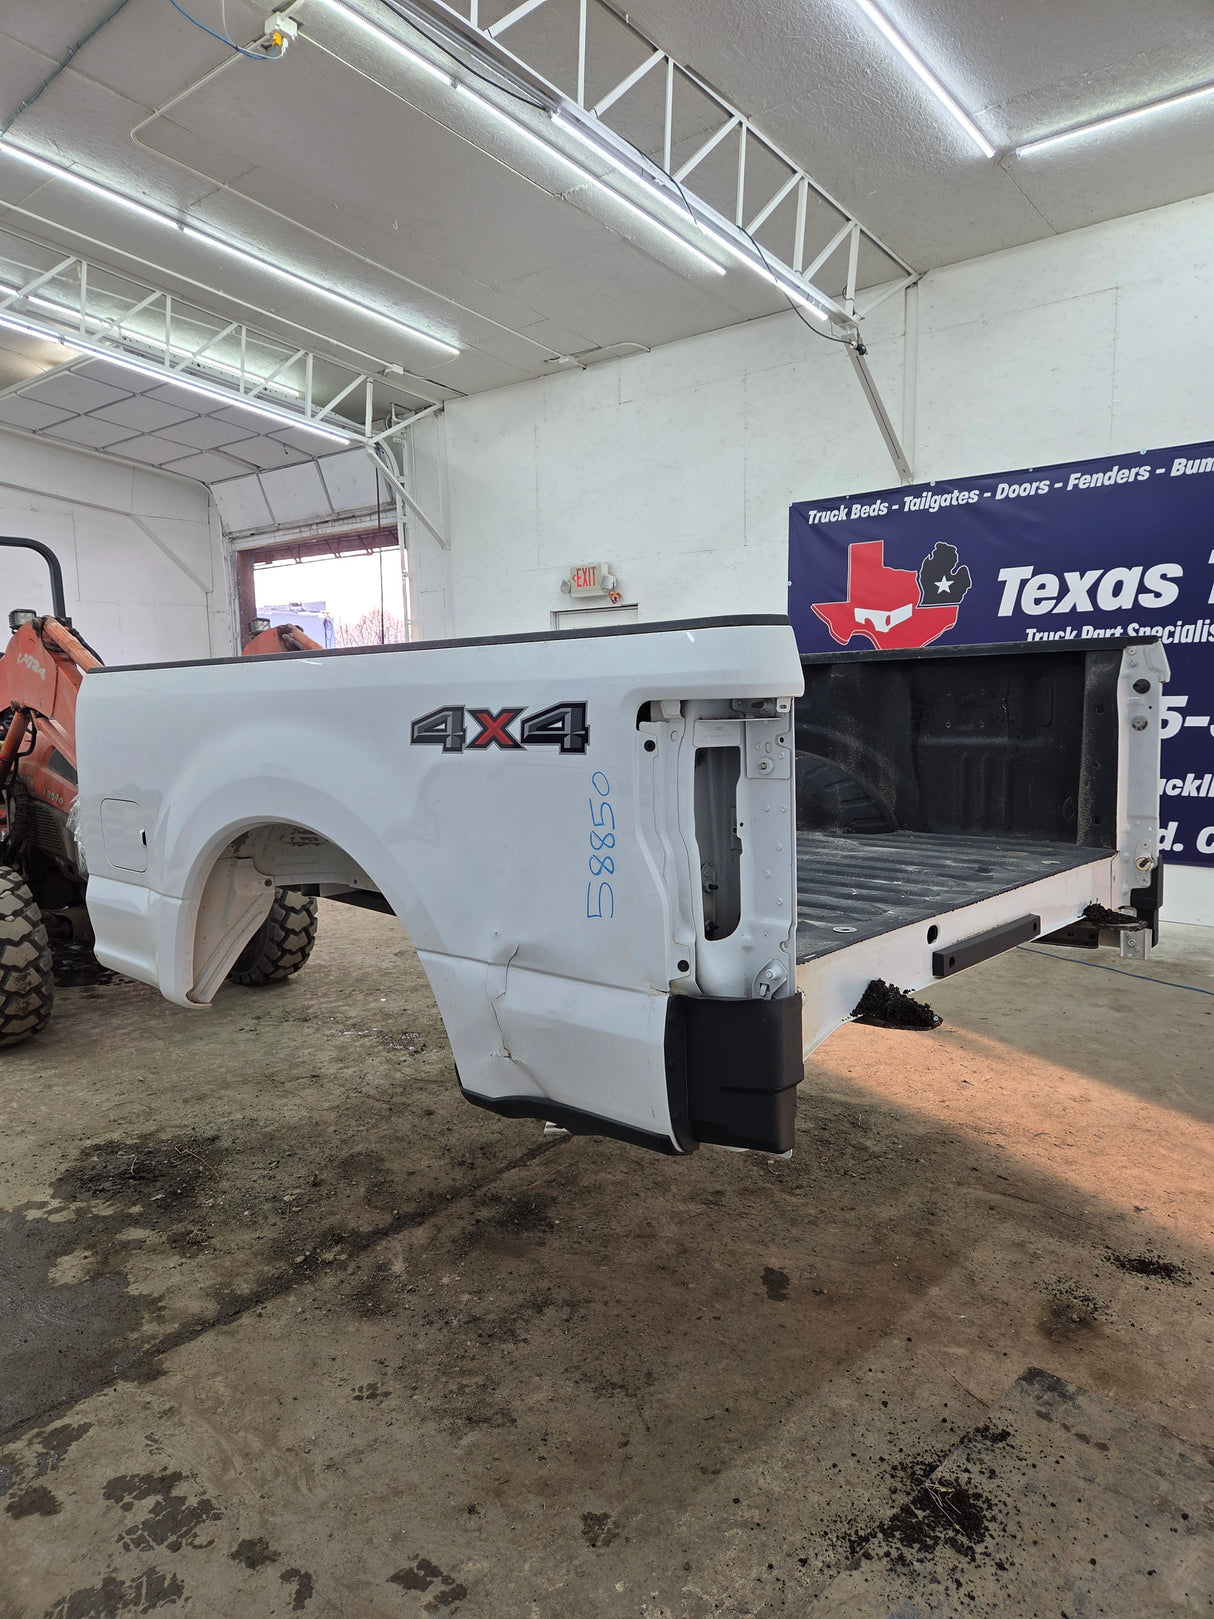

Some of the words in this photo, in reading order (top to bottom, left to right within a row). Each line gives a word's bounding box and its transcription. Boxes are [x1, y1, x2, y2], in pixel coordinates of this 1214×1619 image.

[808, 505, 848, 525] Truck
[850, 500, 889, 520] Beds
[903, 488, 980, 513] Tailgates
[995, 479, 1051, 500] Doors
[1066, 465, 1151, 491] Fenders
[576, 566, 597, 588] EXIT
[997, 561, 1184, 617] Texas
[1160, 695, 1214, 740] 5-
[587, 771, 615, 919] 58850
